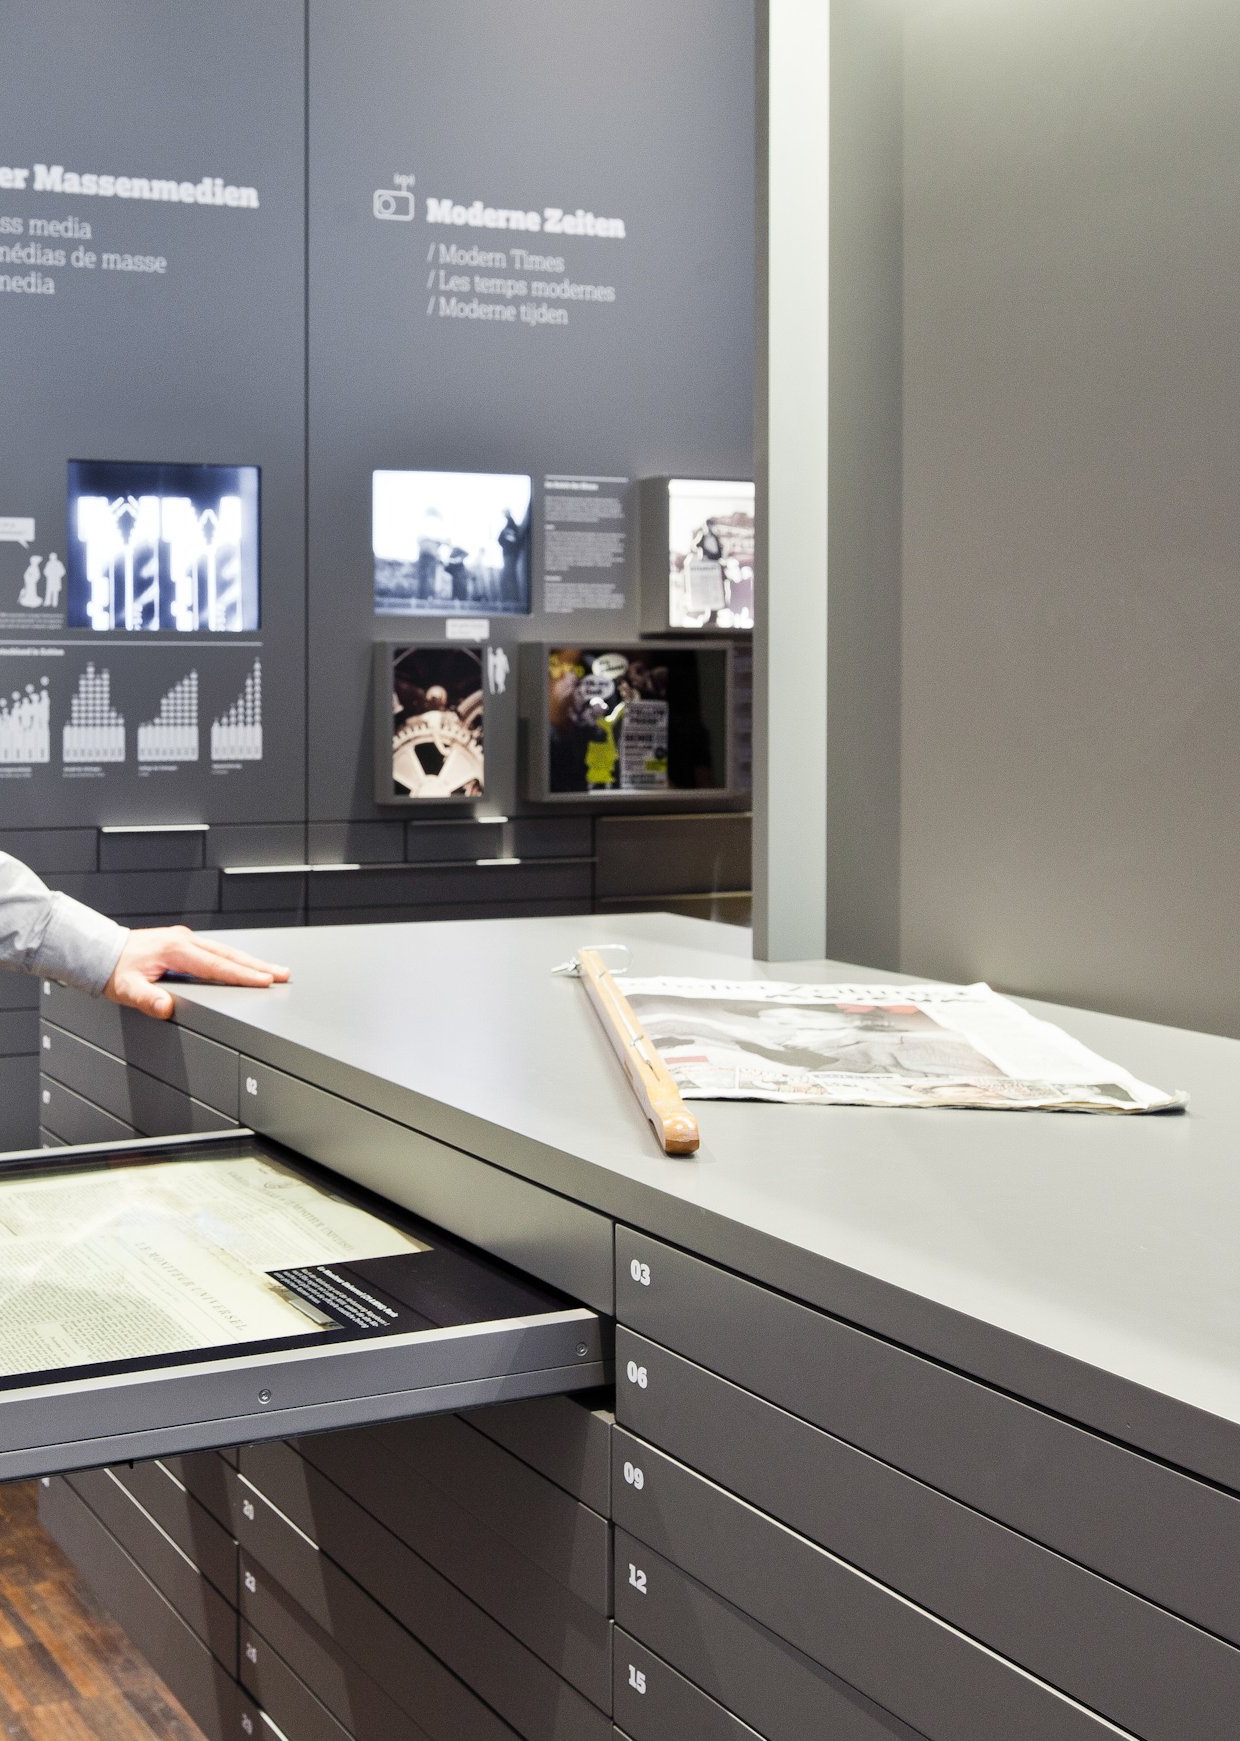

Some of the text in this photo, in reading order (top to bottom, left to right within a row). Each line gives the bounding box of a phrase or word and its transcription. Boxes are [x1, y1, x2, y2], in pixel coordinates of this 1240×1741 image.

[34, 163, 260, 208] Massenmedien
[29, 215, 93, 240] media
[426, 197, 627, 239] Moderne Zeiten
[71, 244, 98, 269] de
[102, 252, 167, 274] masse
[510, 248, 565, 273] Times
[474, 273, 528, 297] temps
[531, 280, 616, 303] modernes
[520, 301, 569, 327] tijden
[631, 1259, 651, 1286] 03
[627, 1361, 648, 1389] 06
[624, 1461, 644, 1490] 09
[628, 1563, 647, 1594] 12
[629, 1664, 646, 1694] 15
